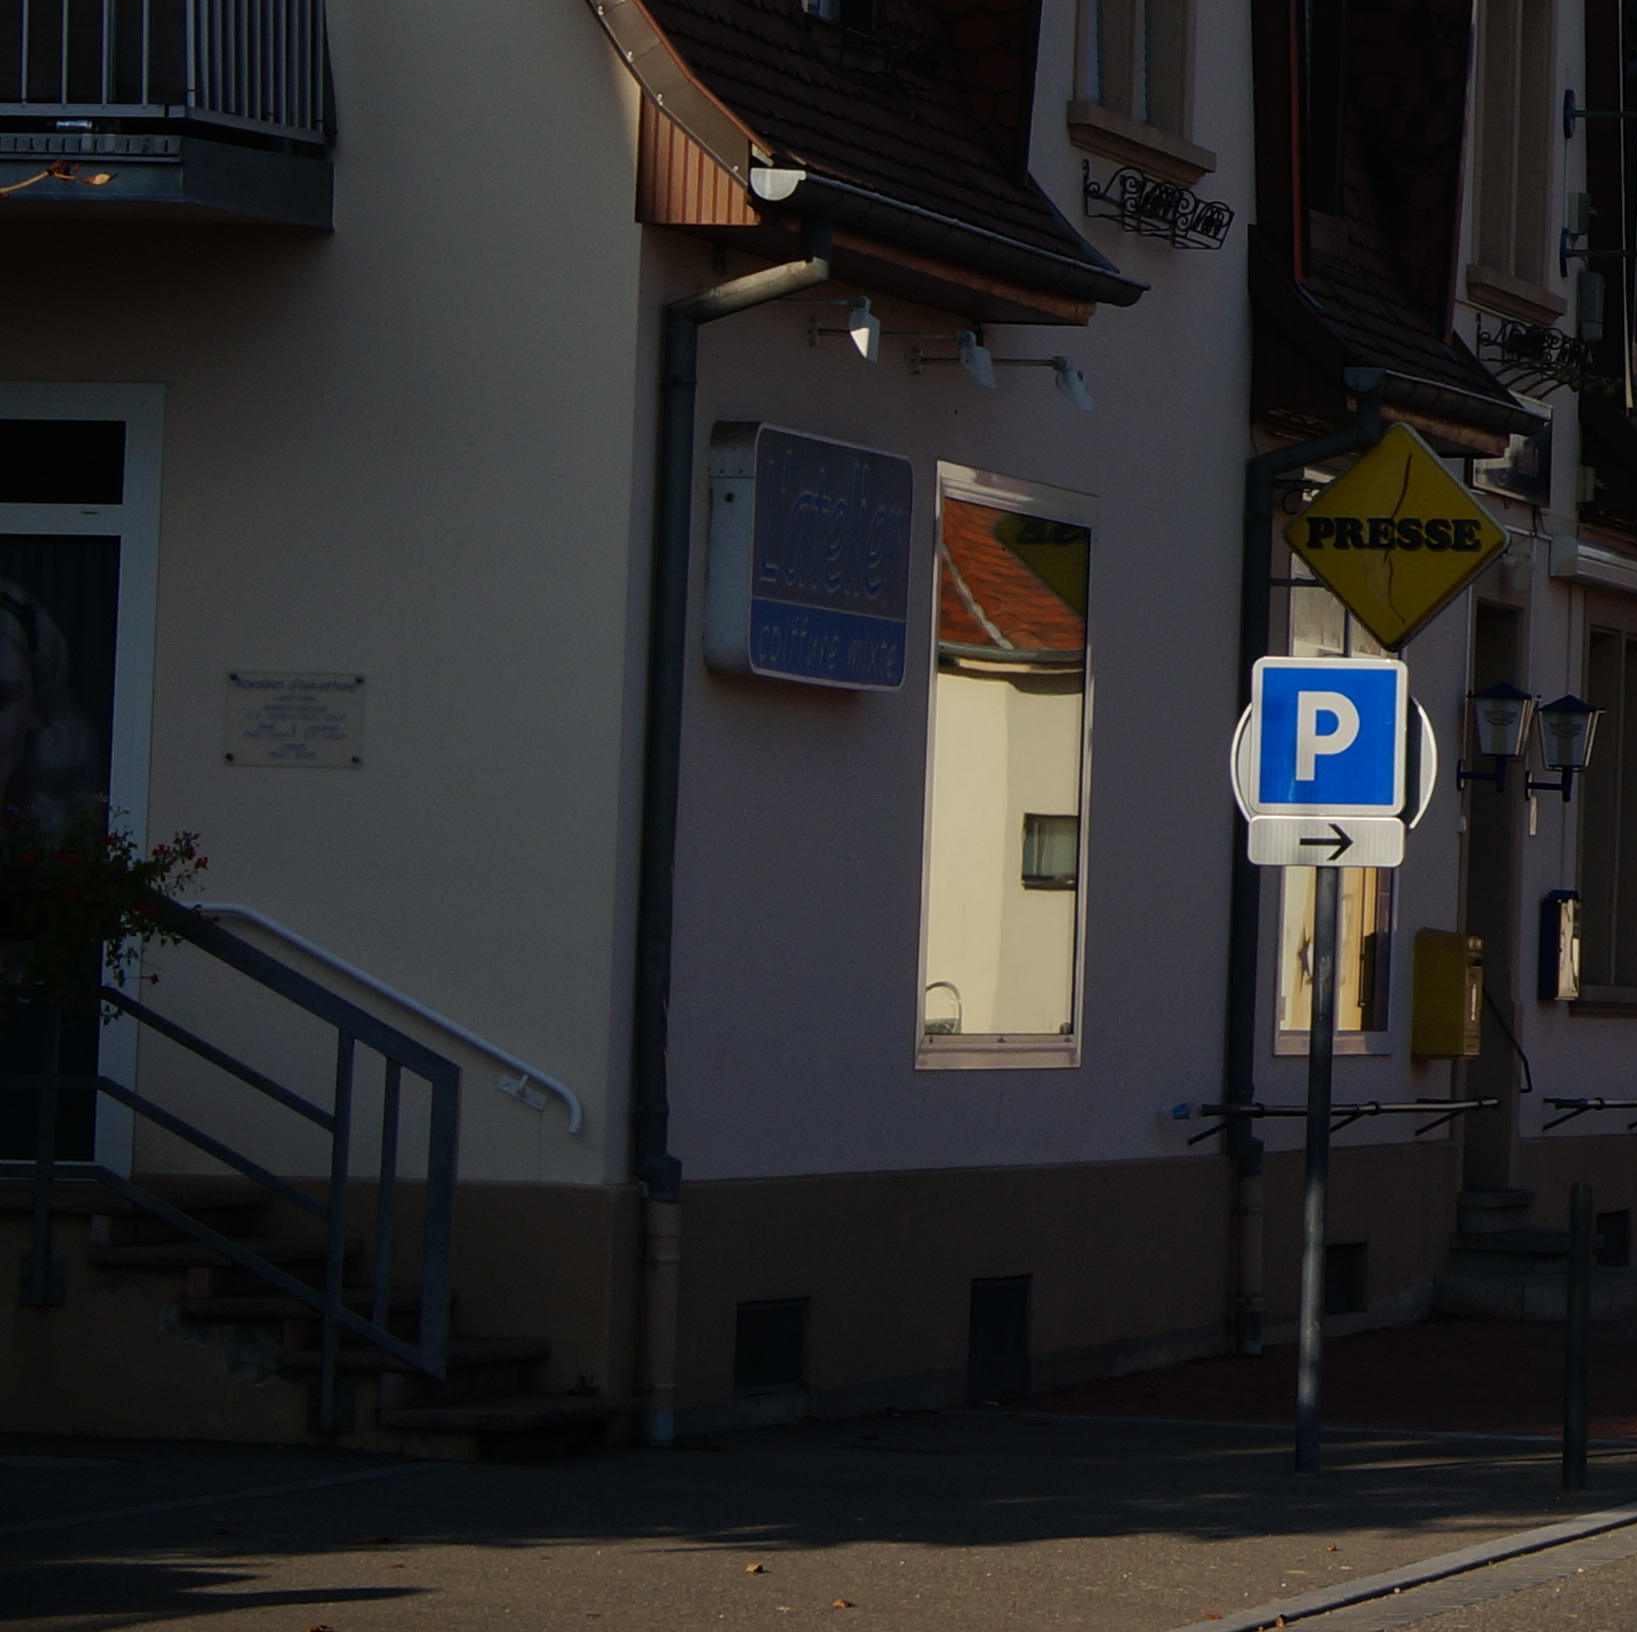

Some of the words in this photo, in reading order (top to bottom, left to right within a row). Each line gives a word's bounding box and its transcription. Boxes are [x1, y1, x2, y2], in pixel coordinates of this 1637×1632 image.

[1305, 516, 1482, 551] PRESSE
[758, 615, 840, 670] coiffure
[847, 633, 898, 679] mixte
[1296, 691, 1360, 781] P
